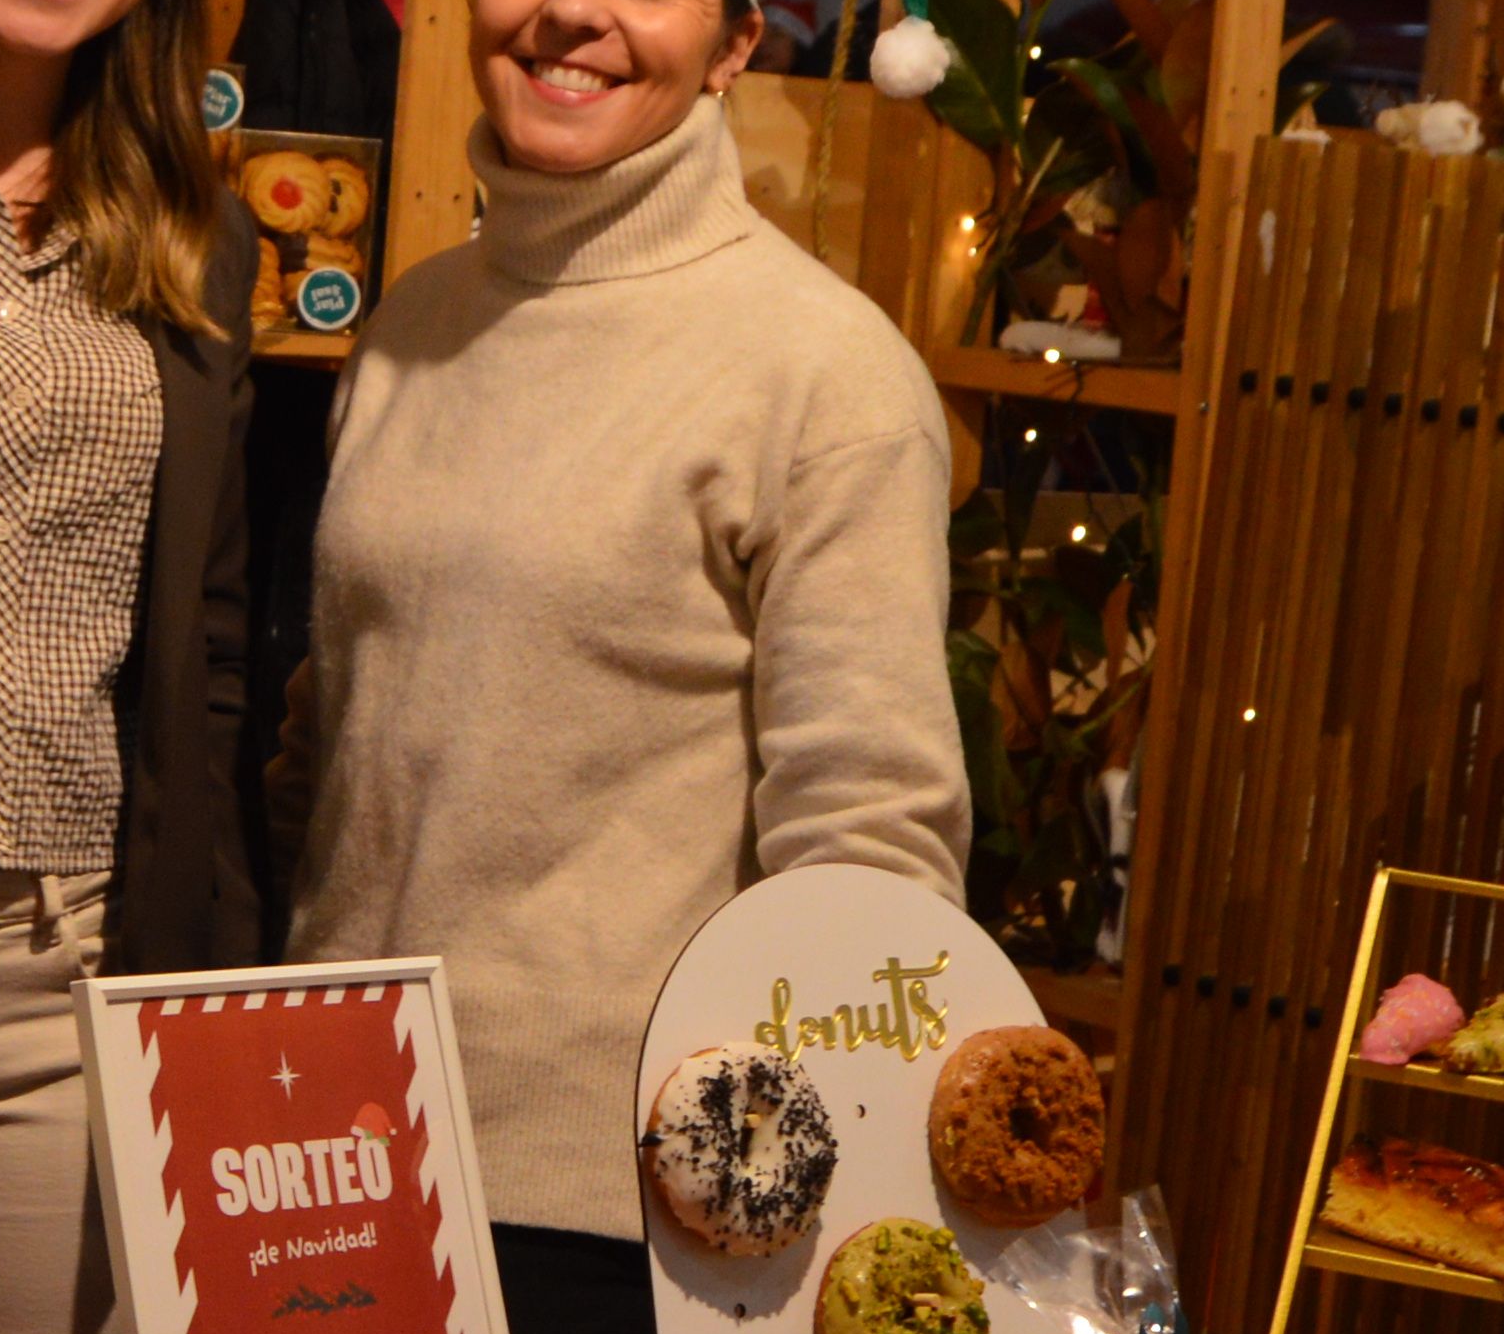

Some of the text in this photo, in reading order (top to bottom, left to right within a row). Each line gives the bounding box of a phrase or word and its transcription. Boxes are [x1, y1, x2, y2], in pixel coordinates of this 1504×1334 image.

[754, 949, 950, 1063] donuts
[211, 1136, 393, 1216] SORTEO
[249, 1221, 379, 1277] ¡de Navidad!
